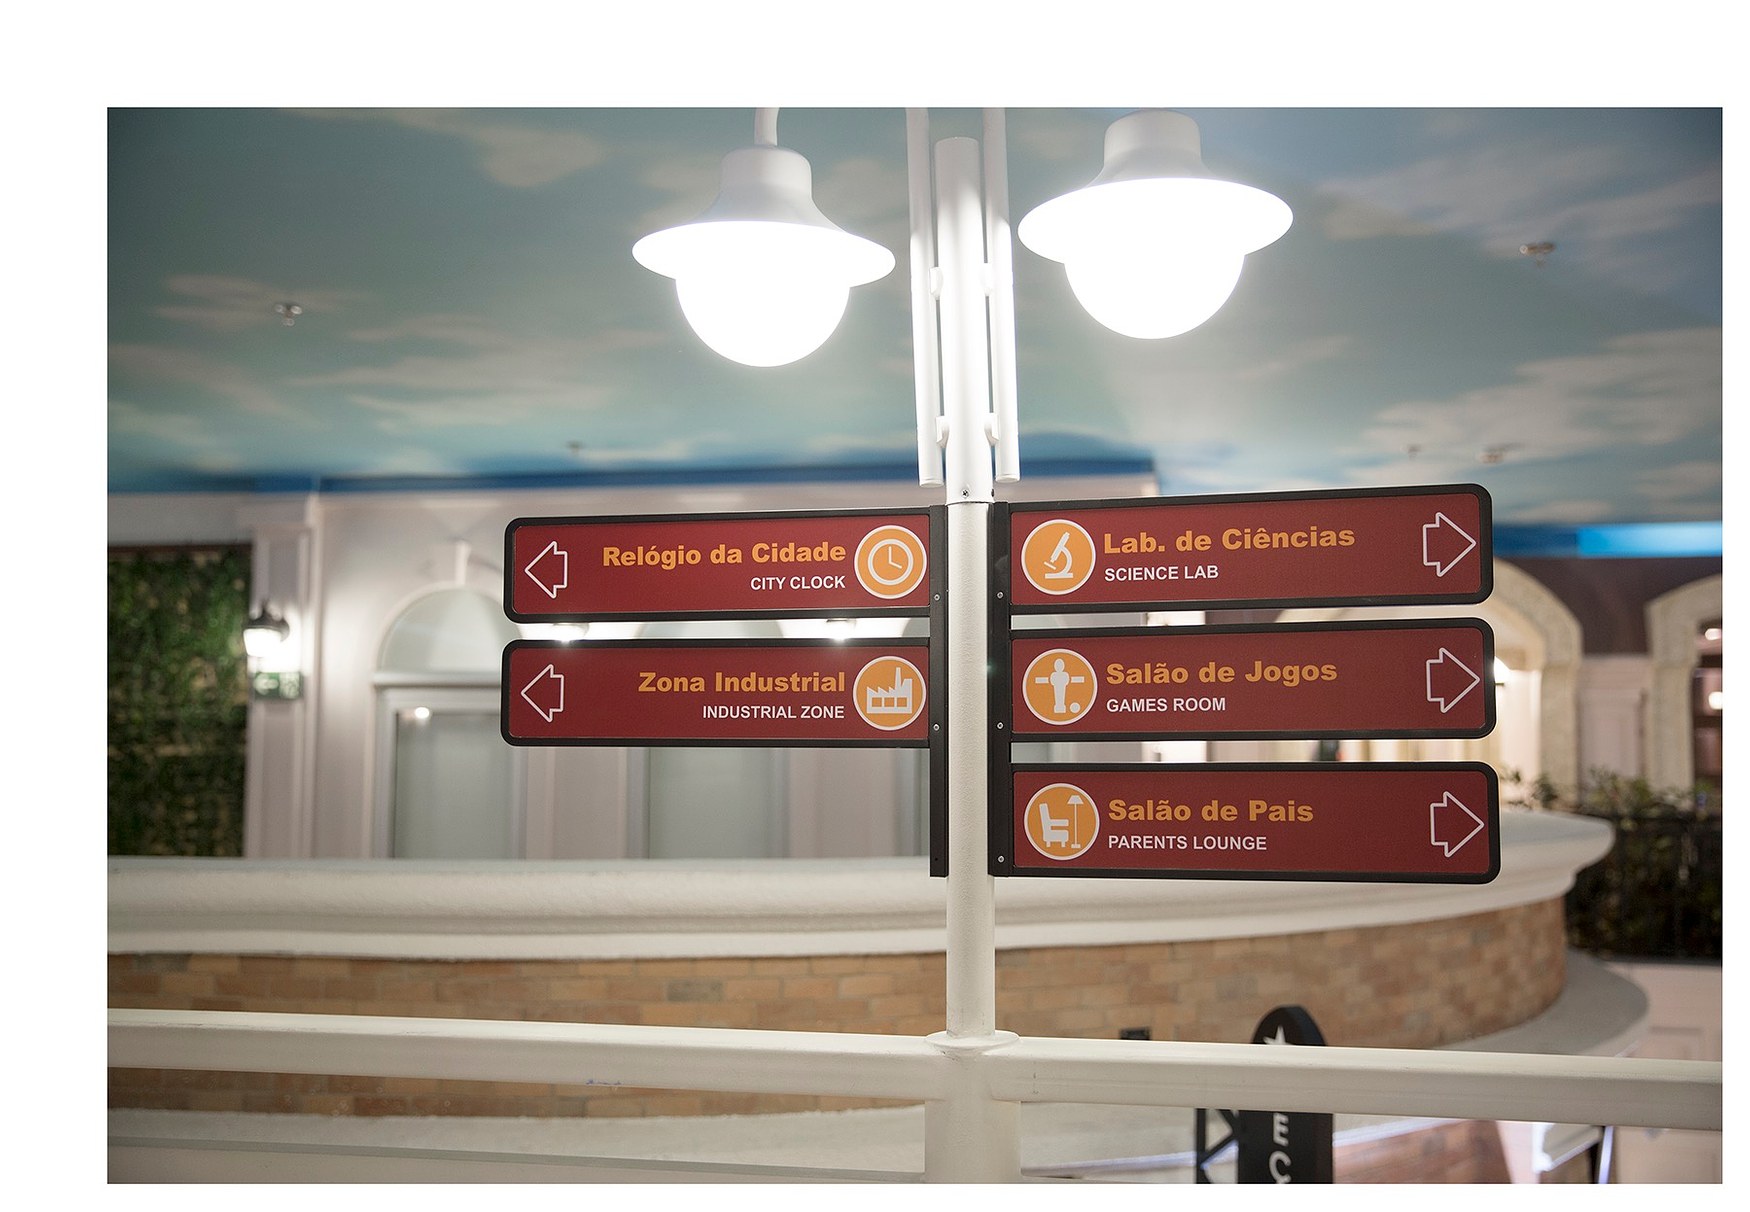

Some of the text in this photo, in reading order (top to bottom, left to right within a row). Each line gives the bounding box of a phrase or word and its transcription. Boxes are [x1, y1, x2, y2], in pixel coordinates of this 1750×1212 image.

[1103, 525, 1356, 555] Lab. de Ciências
[602, 541, 847, 571] Relógio da Cidade
[1104, 564, 1219, 582] SCIENCE LAB
[750, 575, 846, 591] CITY CLOCK
[638, 672, 845, 693] Zona Industrial
[1106, 661, 1338, 688] Salão de Jogos
[702, 705, 845, 720] INDUSTRIAL ZONE
[1106, 697, 1226, 713] GAMES ROOM
[1108, 799, 1314, 822] Salão de Pais
[1108, 835, 1267, 851] PARENTS LOUNGE
